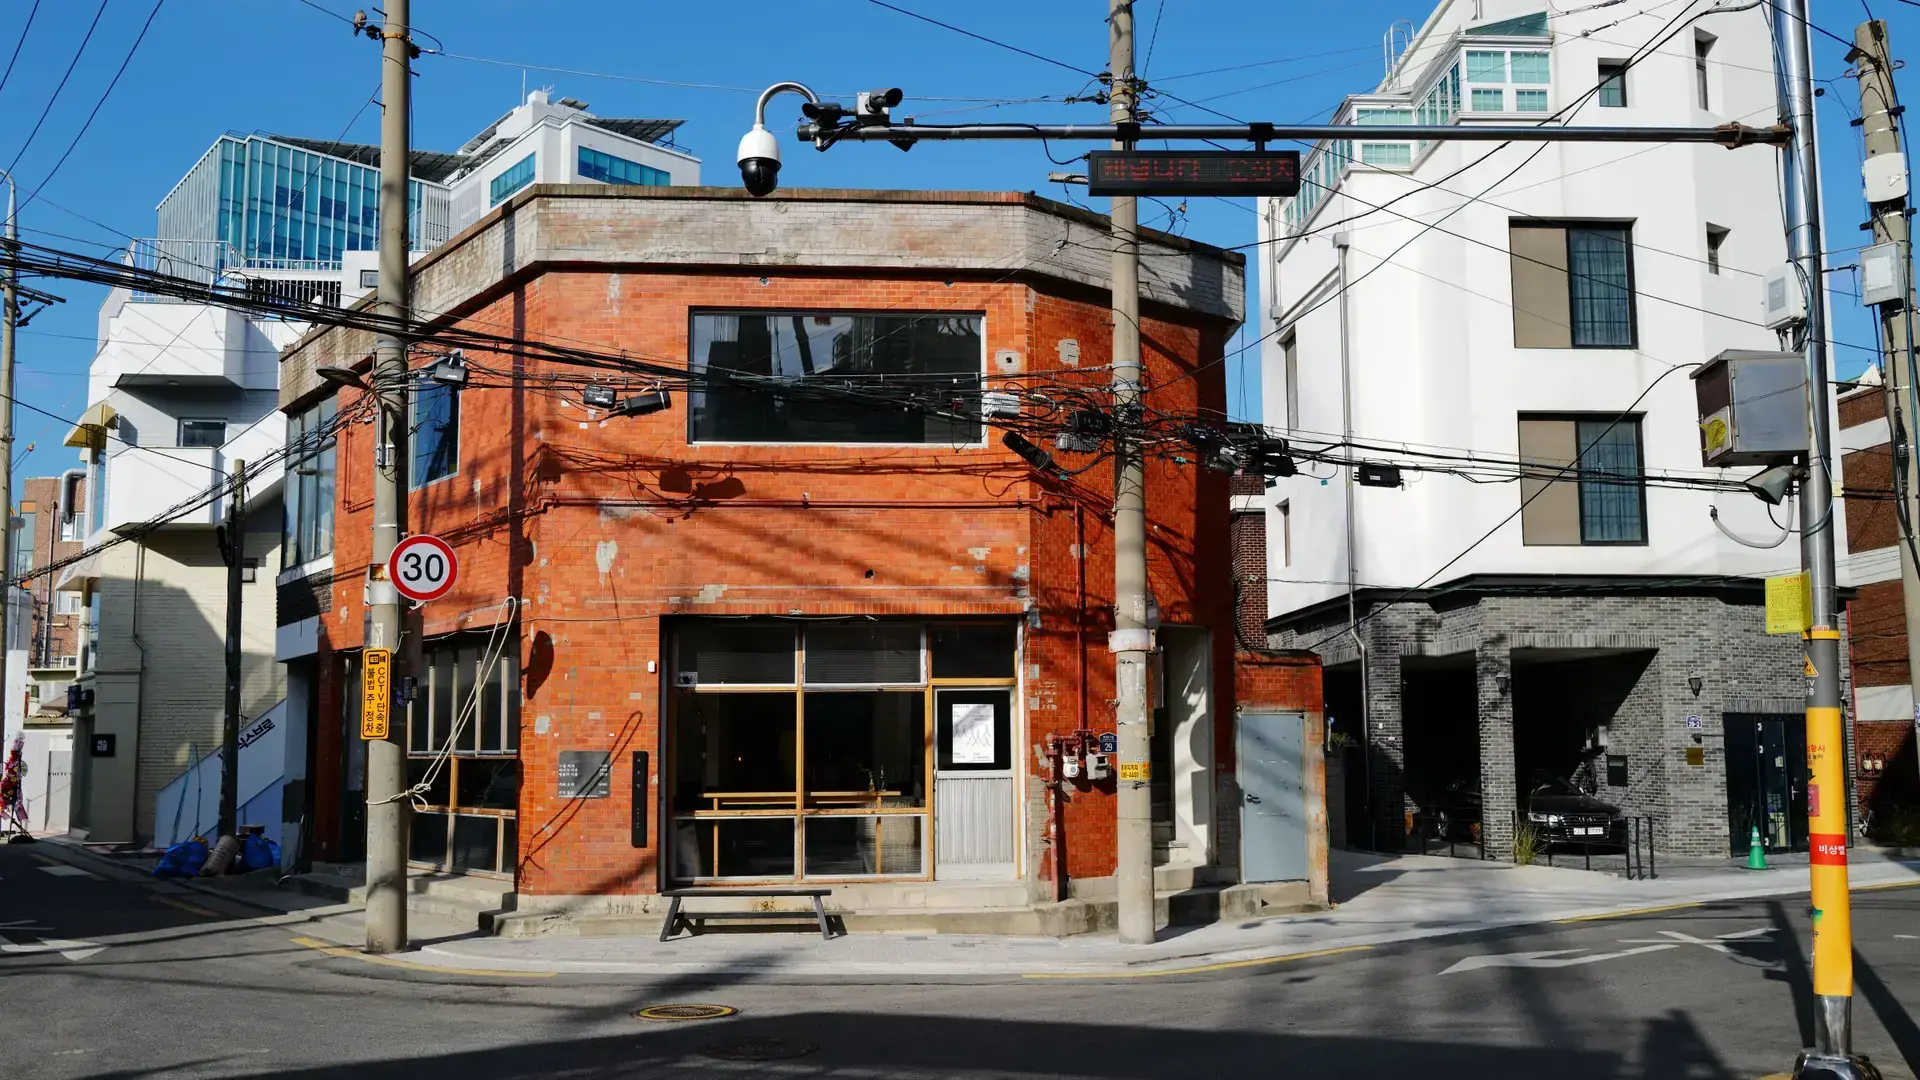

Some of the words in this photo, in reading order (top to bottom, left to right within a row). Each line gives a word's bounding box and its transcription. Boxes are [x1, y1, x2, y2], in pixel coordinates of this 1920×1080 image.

[403, 553, 444, 582] 30
[367, 667, 375, 690] 불법
[1104, 742, 1113, 752] 29
